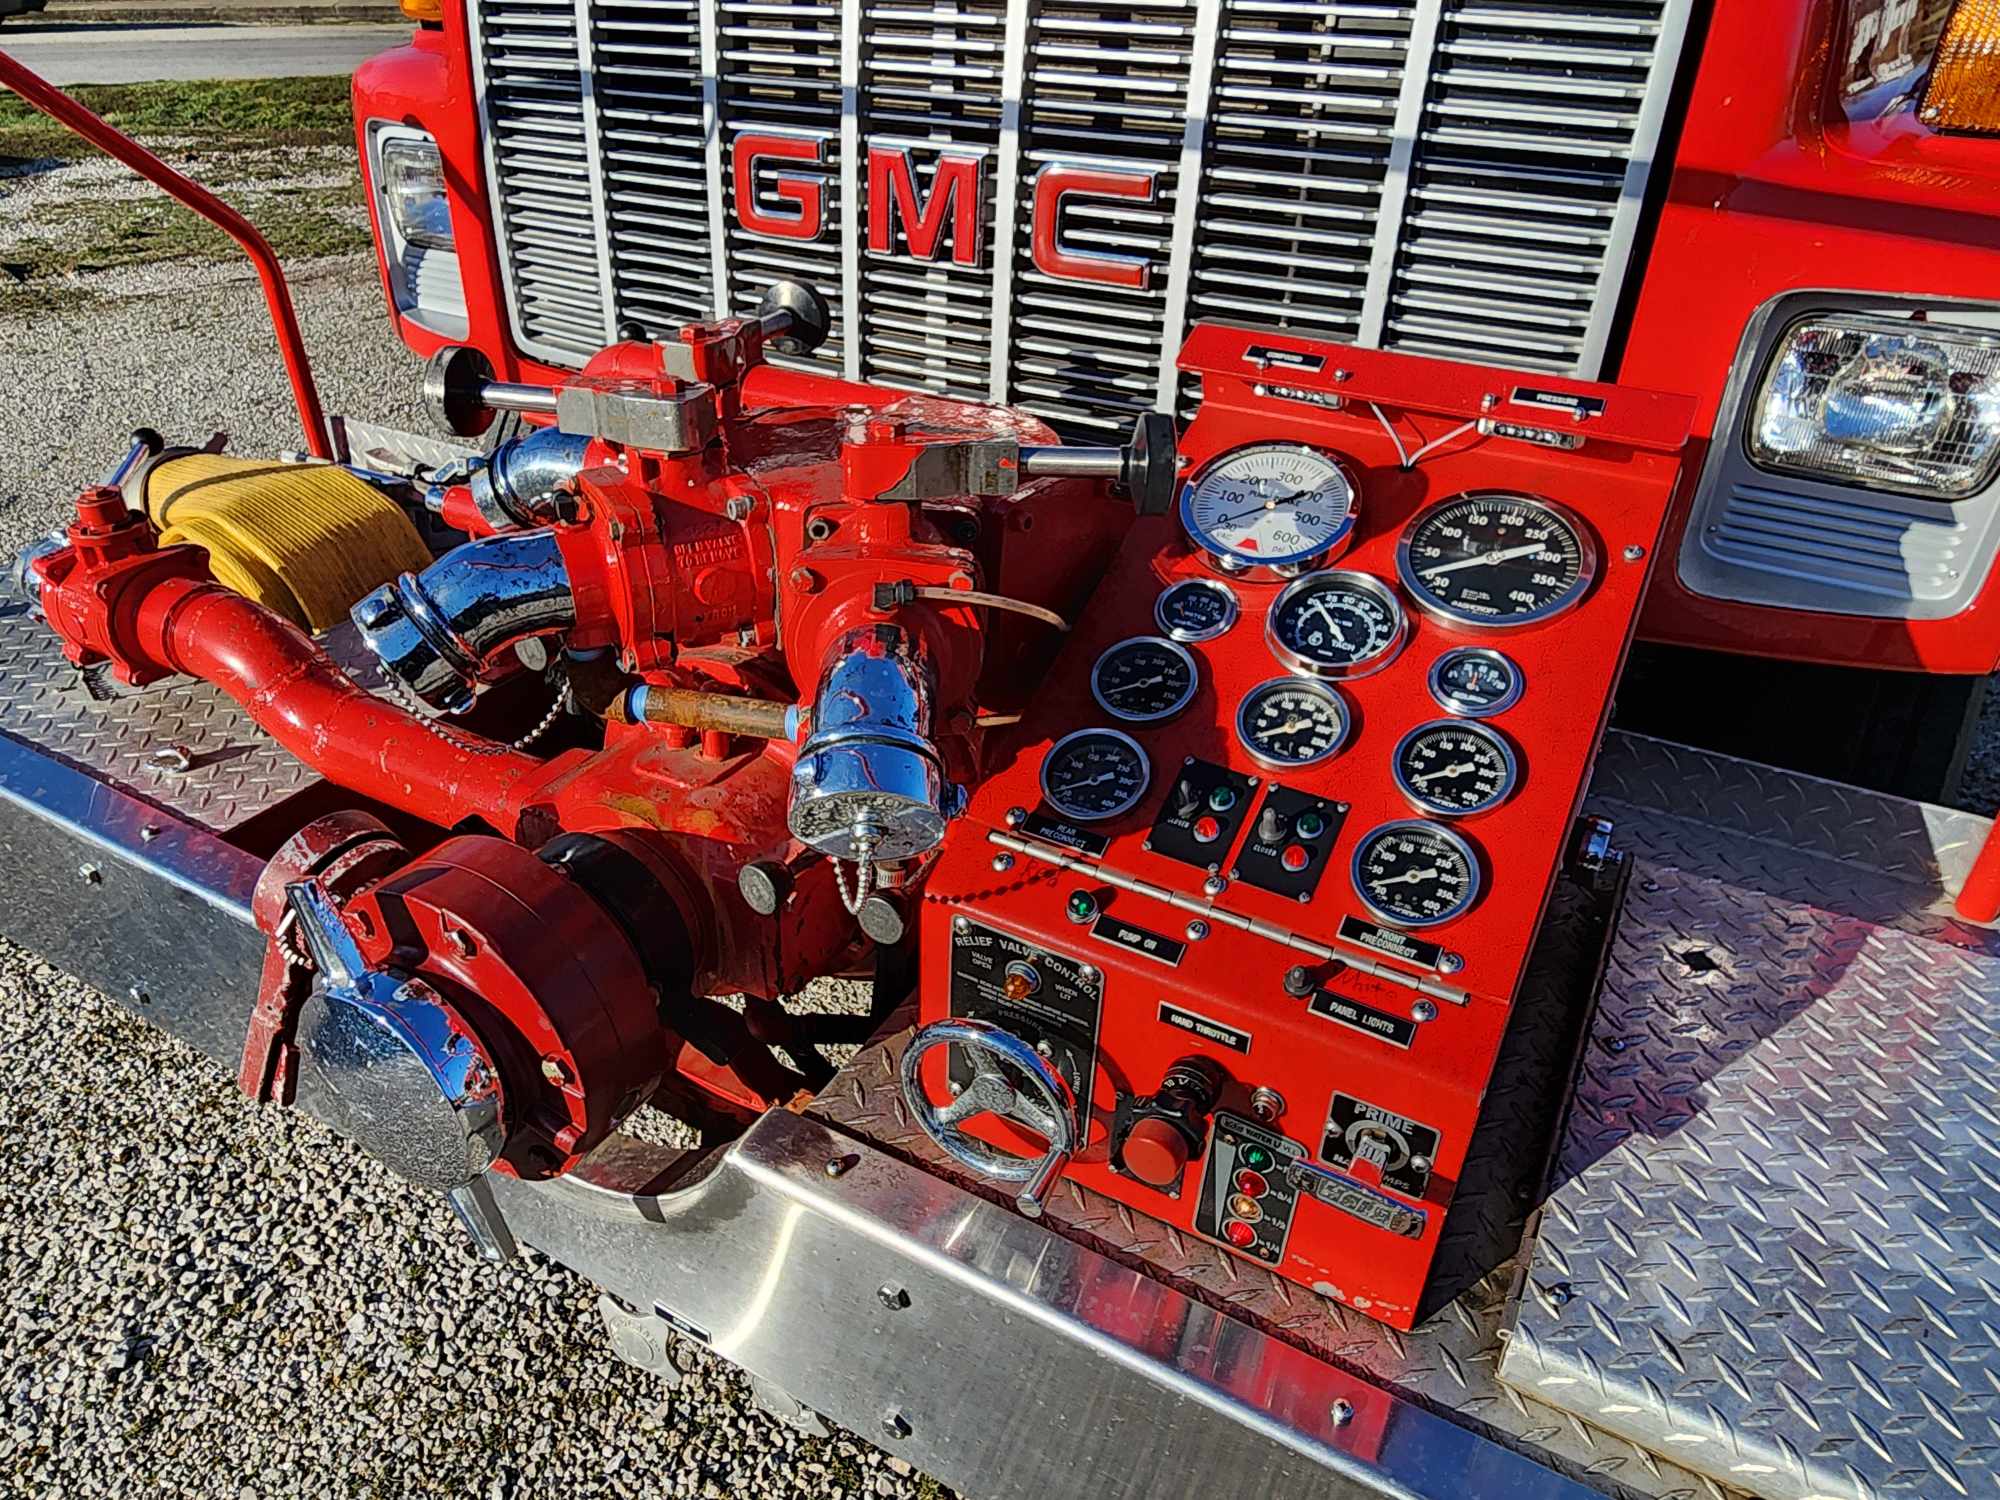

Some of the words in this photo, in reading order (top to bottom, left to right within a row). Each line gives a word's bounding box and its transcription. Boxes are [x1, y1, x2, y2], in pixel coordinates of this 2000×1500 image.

[732, 129, 1160, 291] GMC
[1276, 472, 1303, 485] 300
[1219, 490, 1244, 504] 100
[1299, 490, 1323, 503] 00
[1217, 514, 1227, 523] 0
[1294, 511, 1320, 526] 500
[1468, 515, 1488, 526] 150
[1500, 515, 1524, 526] 200
[1273, 530, 1300, 545] 600
[1442, 527, 1462, 538] 100
[1525, 528, 1548, 540] 250
[1424, 547, 1440, 557] 50
[1536, 551, 1561, 563] 300
[1433, 577, 1450, 587] 30
[1532, 573, 1556, 586] 350
[1509, 590, 1535, 603] 400
[1421, 749, 1436, 758] 100
[1478, 768, 1494, 778] 300
[1461, 792, 1478, 801] 400
[1058, 824, 1077, 835] REAR
[1381, 852, 1396, 862] 100
[1372, 865, 1384, 874] 50
[1435, 858, 1452, 869] 250
[1422, 900, 1440, 910] 400
[1118, 929, 1142, 943] PUMP
[1377, 929, 1406, 945] FRONT
[1360, 932, 1417, 958] PRECONNECT
[971, 951, 993, 964] VALVE
[955, 937, 993, 946] RELIEF
[999, 939, 1037, 960] VALVE
[1045, 957, 1097, 1000] CONTROL
[972, 959, 992, 970] OPEN
[1329, 1001, 1357, 1020] PANEL
[1362, 1014, 1394, 1034] LIGHTS
[1171, 1014, 1193, 1029] HAND
[1195, 1022, 1237, 1046] THROTTLE
[1354, 1103, 1416, 1135] PRIME
[1382, 1175, 1411, 1190] MPS
